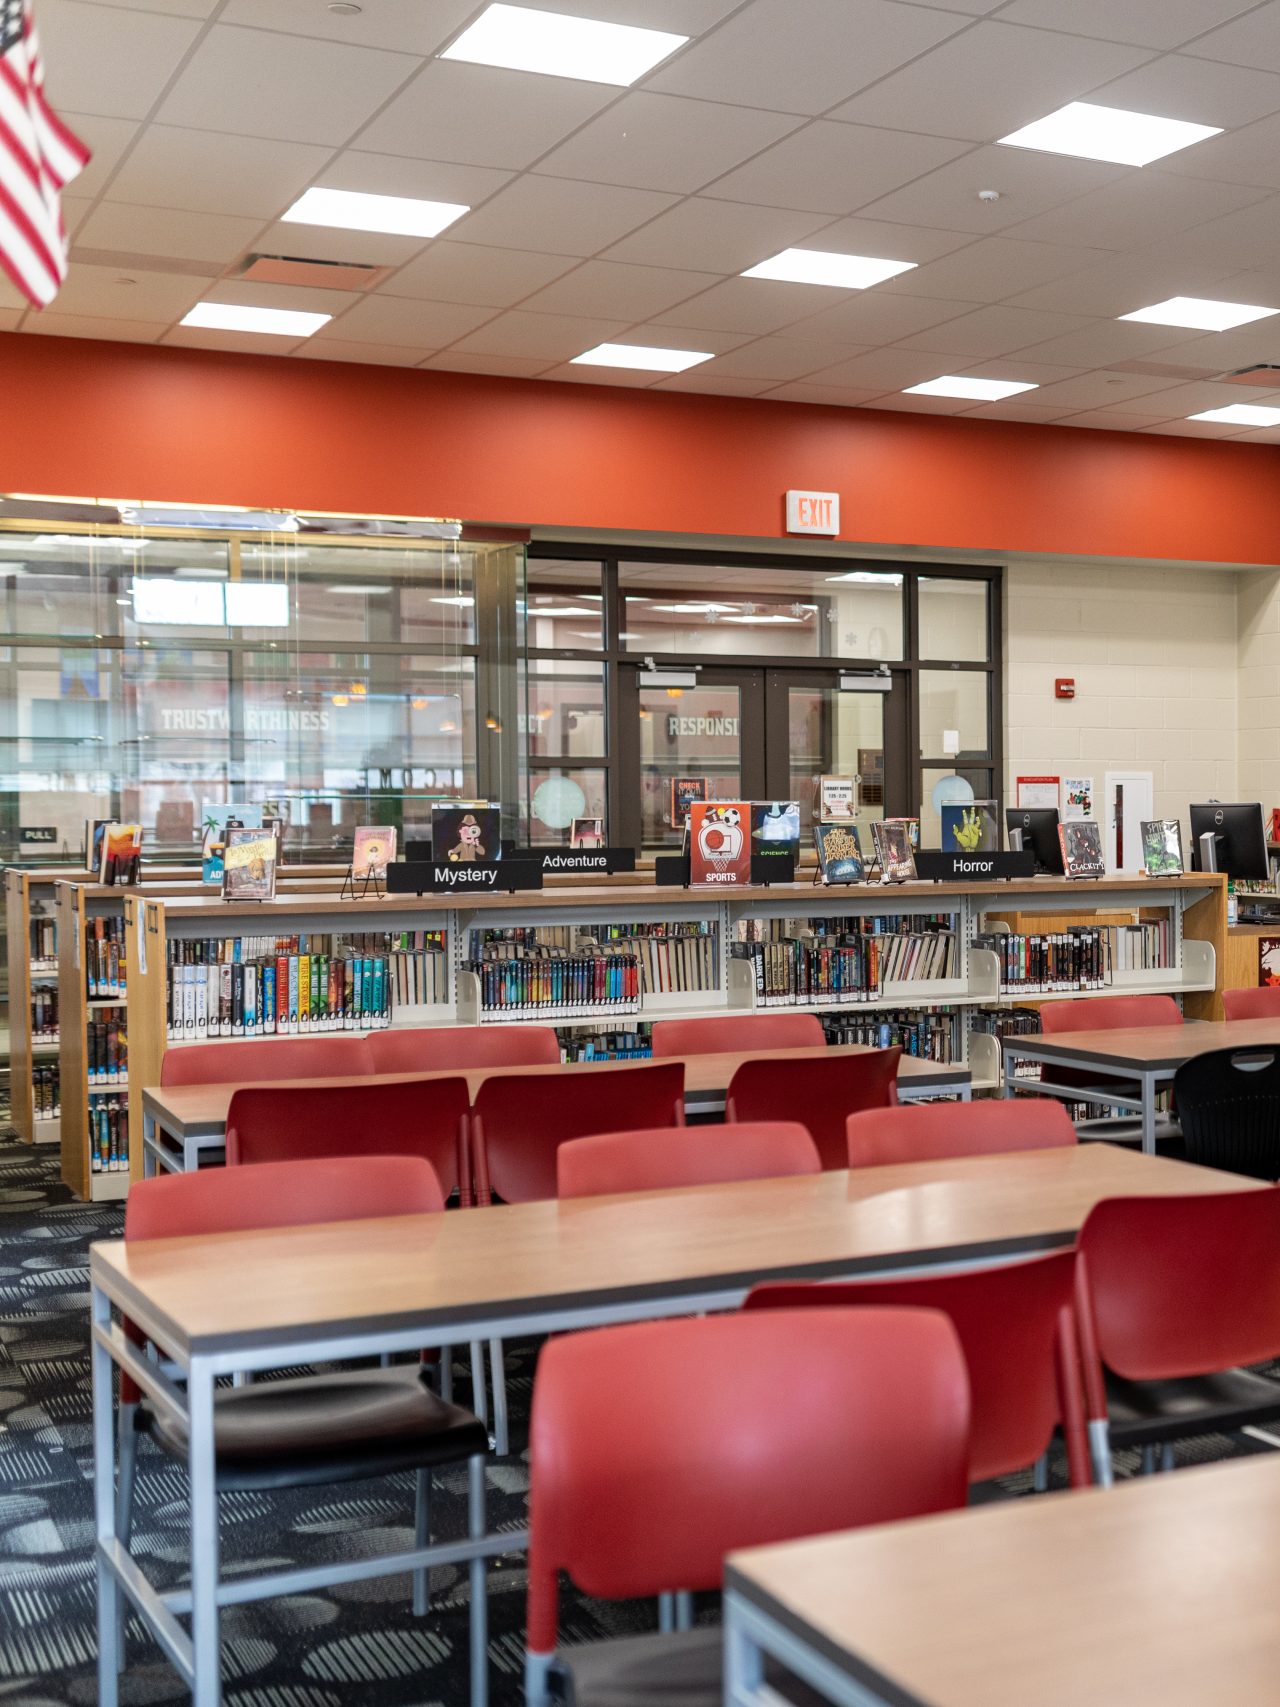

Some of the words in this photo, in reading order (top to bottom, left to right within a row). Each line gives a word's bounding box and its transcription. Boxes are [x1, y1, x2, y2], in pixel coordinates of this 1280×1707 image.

[798, 498, 833, 528] EXIT
[161, 708, 330, 731] TRUSTWRTHINESS
[678, 782, 701, 790] CHECK
[25, 830, 51, 839] PULL
[542, 855, 607, 867] Adventure
[953, 859, 994, 872] Horror
[1070, 861, 1105, 871] CLACKITY
[434, 867, 498, 885] Mystery
[706, 872, 737, 882] SPORTS
[301, 963, 309, 980] FIRE
[301, 981, 309, 1008] STORM
